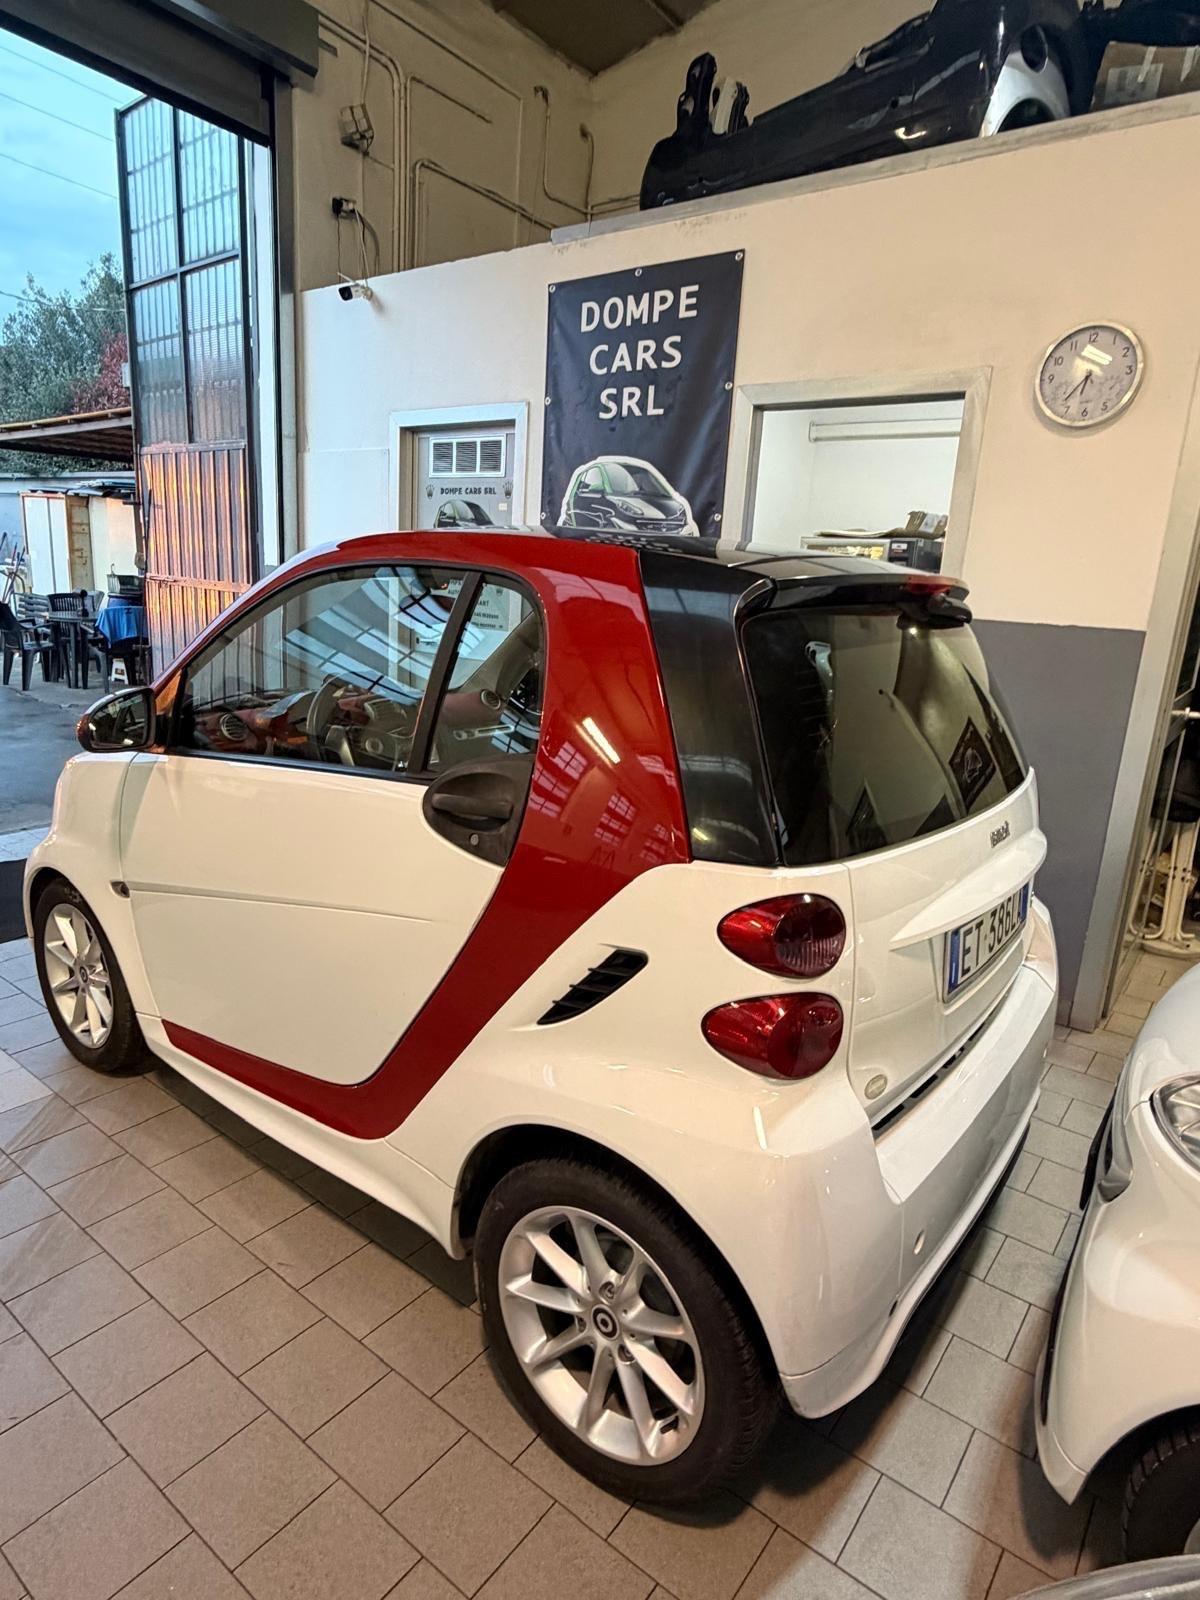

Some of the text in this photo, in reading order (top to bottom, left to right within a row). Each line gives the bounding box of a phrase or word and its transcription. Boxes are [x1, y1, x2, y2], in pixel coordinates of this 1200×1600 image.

[580, 284, 700, 333] DOMPE
[1088, 332, 1099, 343] 12
[1113, 335, 1117, 345] 1
[1070, 341, 1078, 351] 11
[589, 335, 682, 375] CARS
[1122, 347, 1130, 358] 2
[1054, 356, 1064, 366] 10
[1125, 365, 1133, 375] 3
[1048, 374, 1055, 384] 9
[599, 385, 665, 419] SRL
[1101, 401, 1108, 411] 5
[1064, 405, 1070, 415] 7
[1081, 407, 1088, 417] 6
[440, 487, 497, 495] DOMPE CARS SRL
[961, 920, 983, 977] ET
